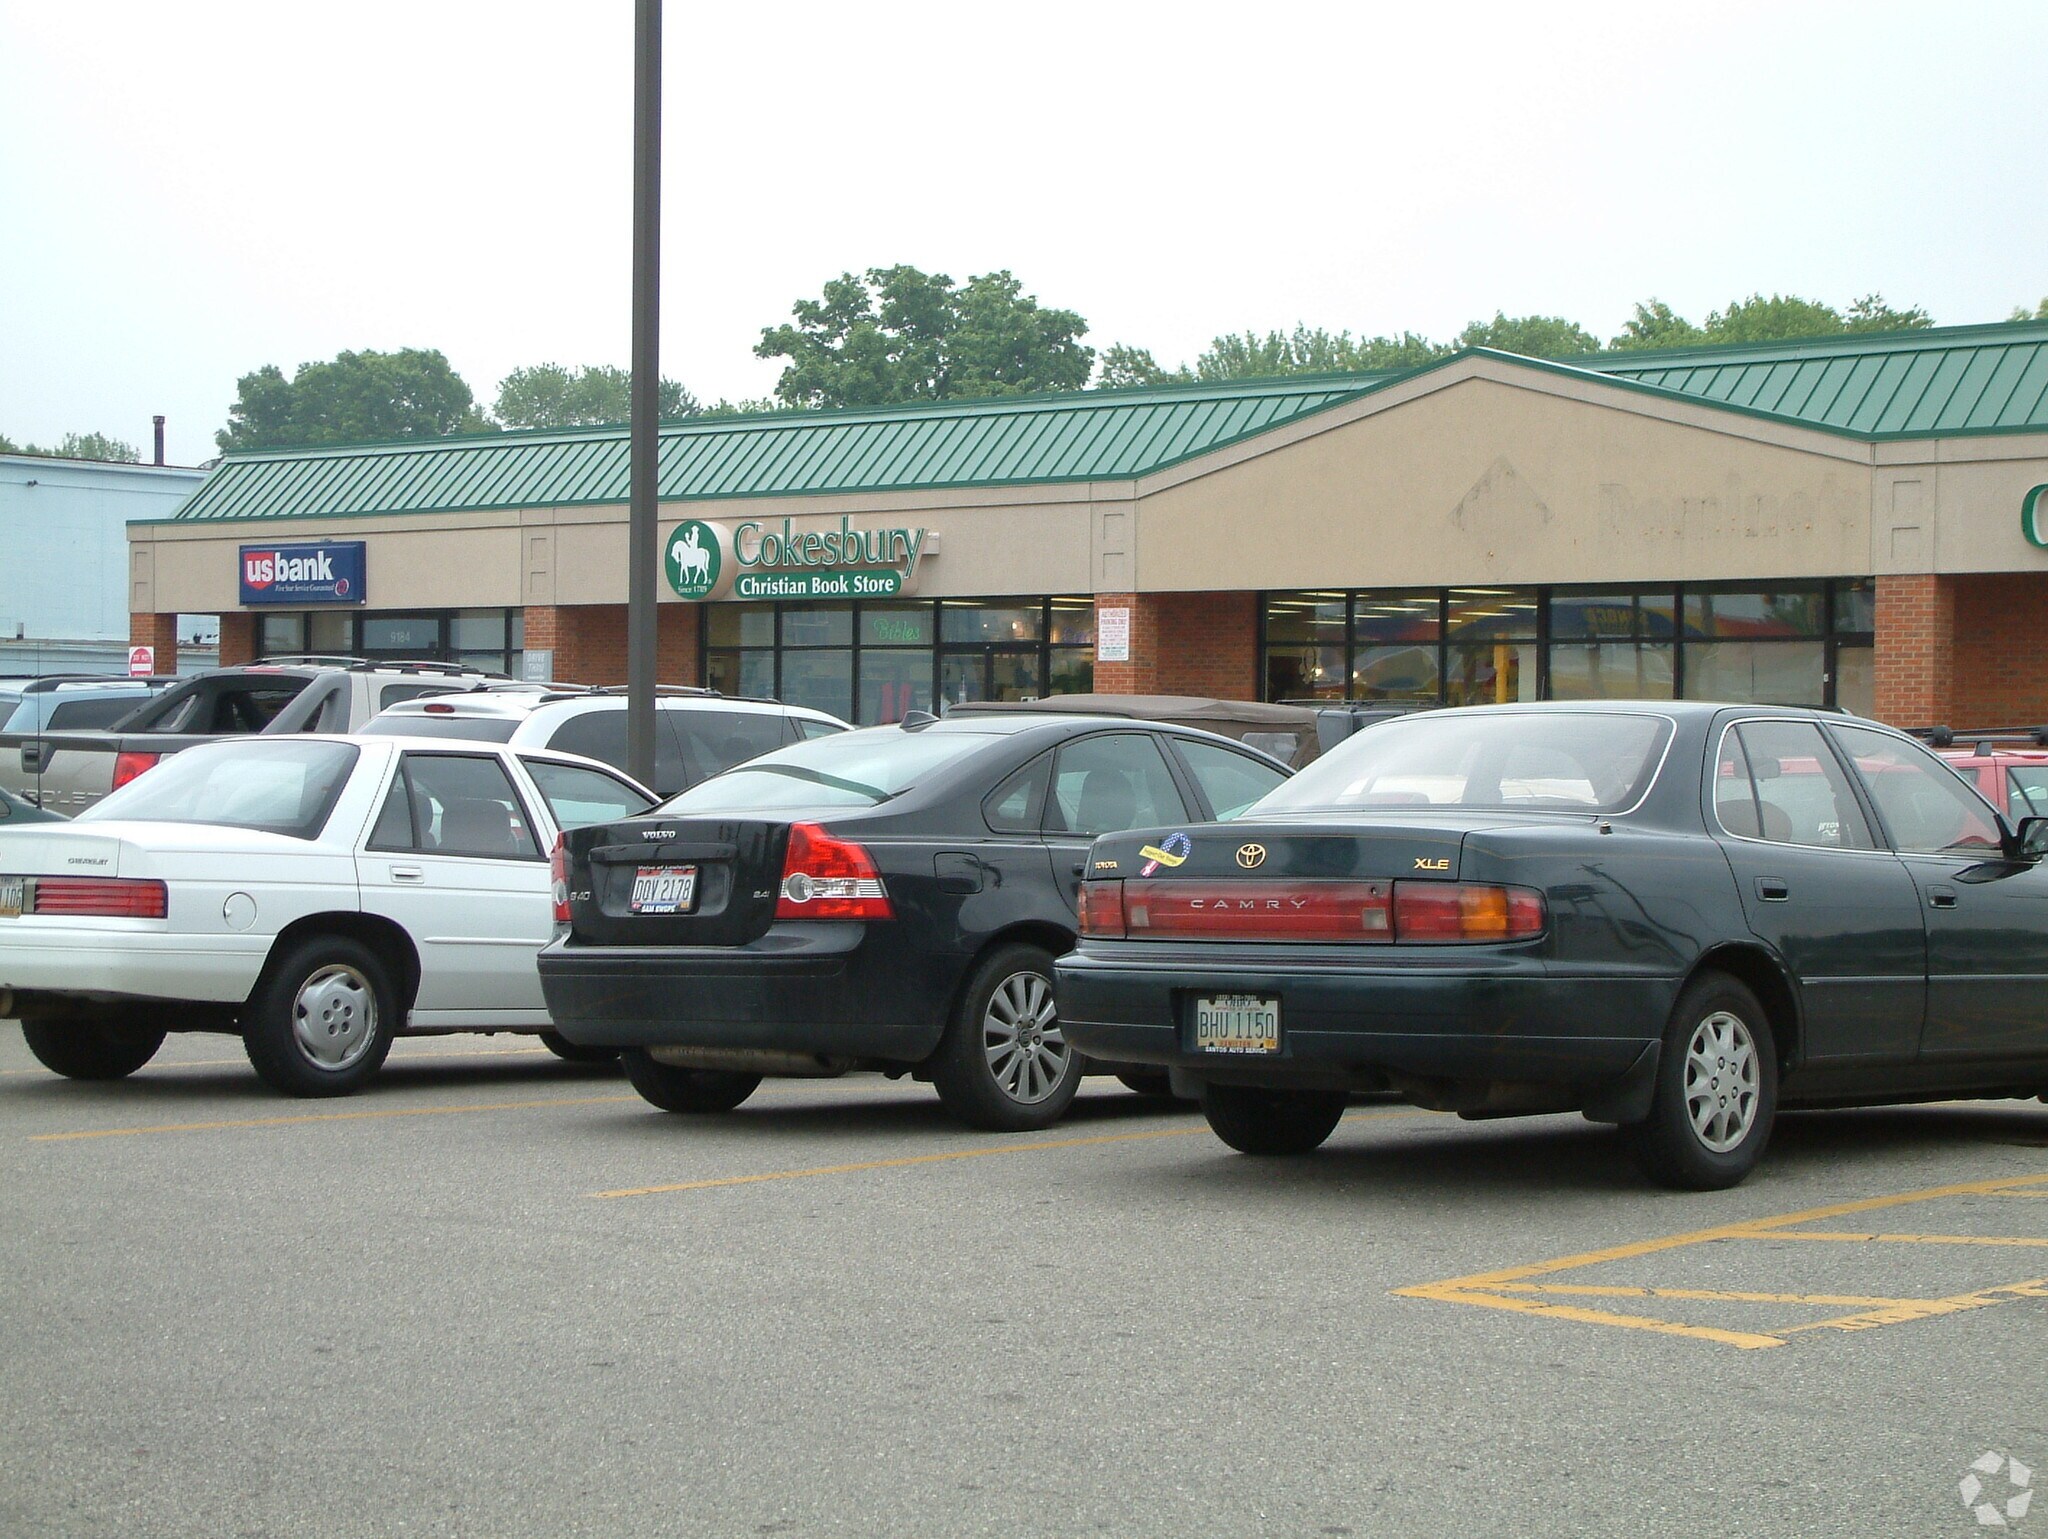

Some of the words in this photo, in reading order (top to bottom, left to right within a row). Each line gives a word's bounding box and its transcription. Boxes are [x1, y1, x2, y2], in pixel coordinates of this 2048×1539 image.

[734, 515, 926, 579] Cokesbury
[740, 577, 807, 595] Christian
[812, 576, 848, 593] Book
[853, 574, 894, 592] Store
[642, 831, 676, 839] VOLVO
[1413, 858, 1450, 870] XLE
[661, 879, 692, 901] 2178
[1190, 899, 1306, 909] CAMRY
[1200, 1012, 1229, 1038] BHU
[1236, 1012, 1275, 1039] 1150
